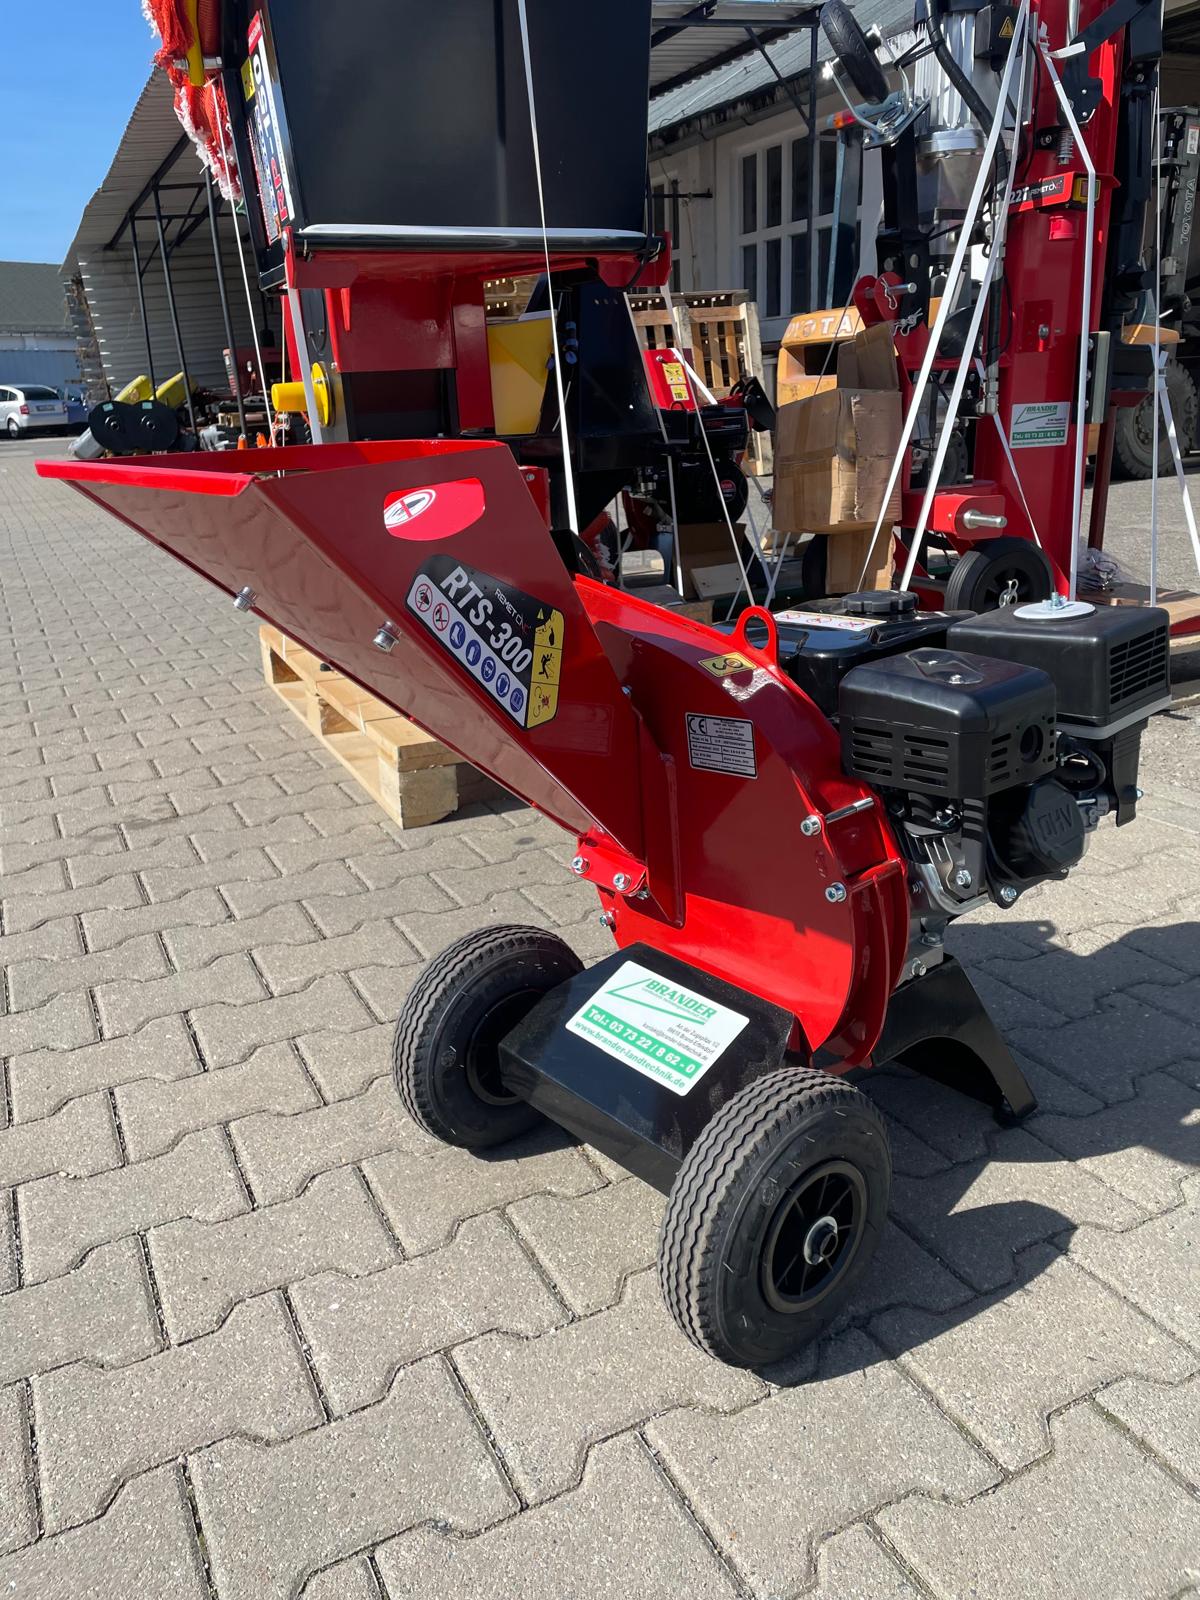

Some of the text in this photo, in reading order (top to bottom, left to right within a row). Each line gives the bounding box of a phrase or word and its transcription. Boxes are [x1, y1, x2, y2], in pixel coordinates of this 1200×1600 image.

[1180, 178, 1195, 244] TOYOTA
[440, 566, 533, 673] RTS-300
[645, 979, 717, 1019] BRANDER
[574, 1020, 687, 1088] www.brander-landtechnik.de
[588, 1009, 610, 1025] Tel.:
[608, 1021, 624, 1034] 03
[623, 1028, 639, 1042] 73
[637, 1036, 653, 1049] 22
[655, 1047, 666, 1058] 8
[664, 1052, 681, 1065] 62
[685, 1063, 696, 1074] 0
